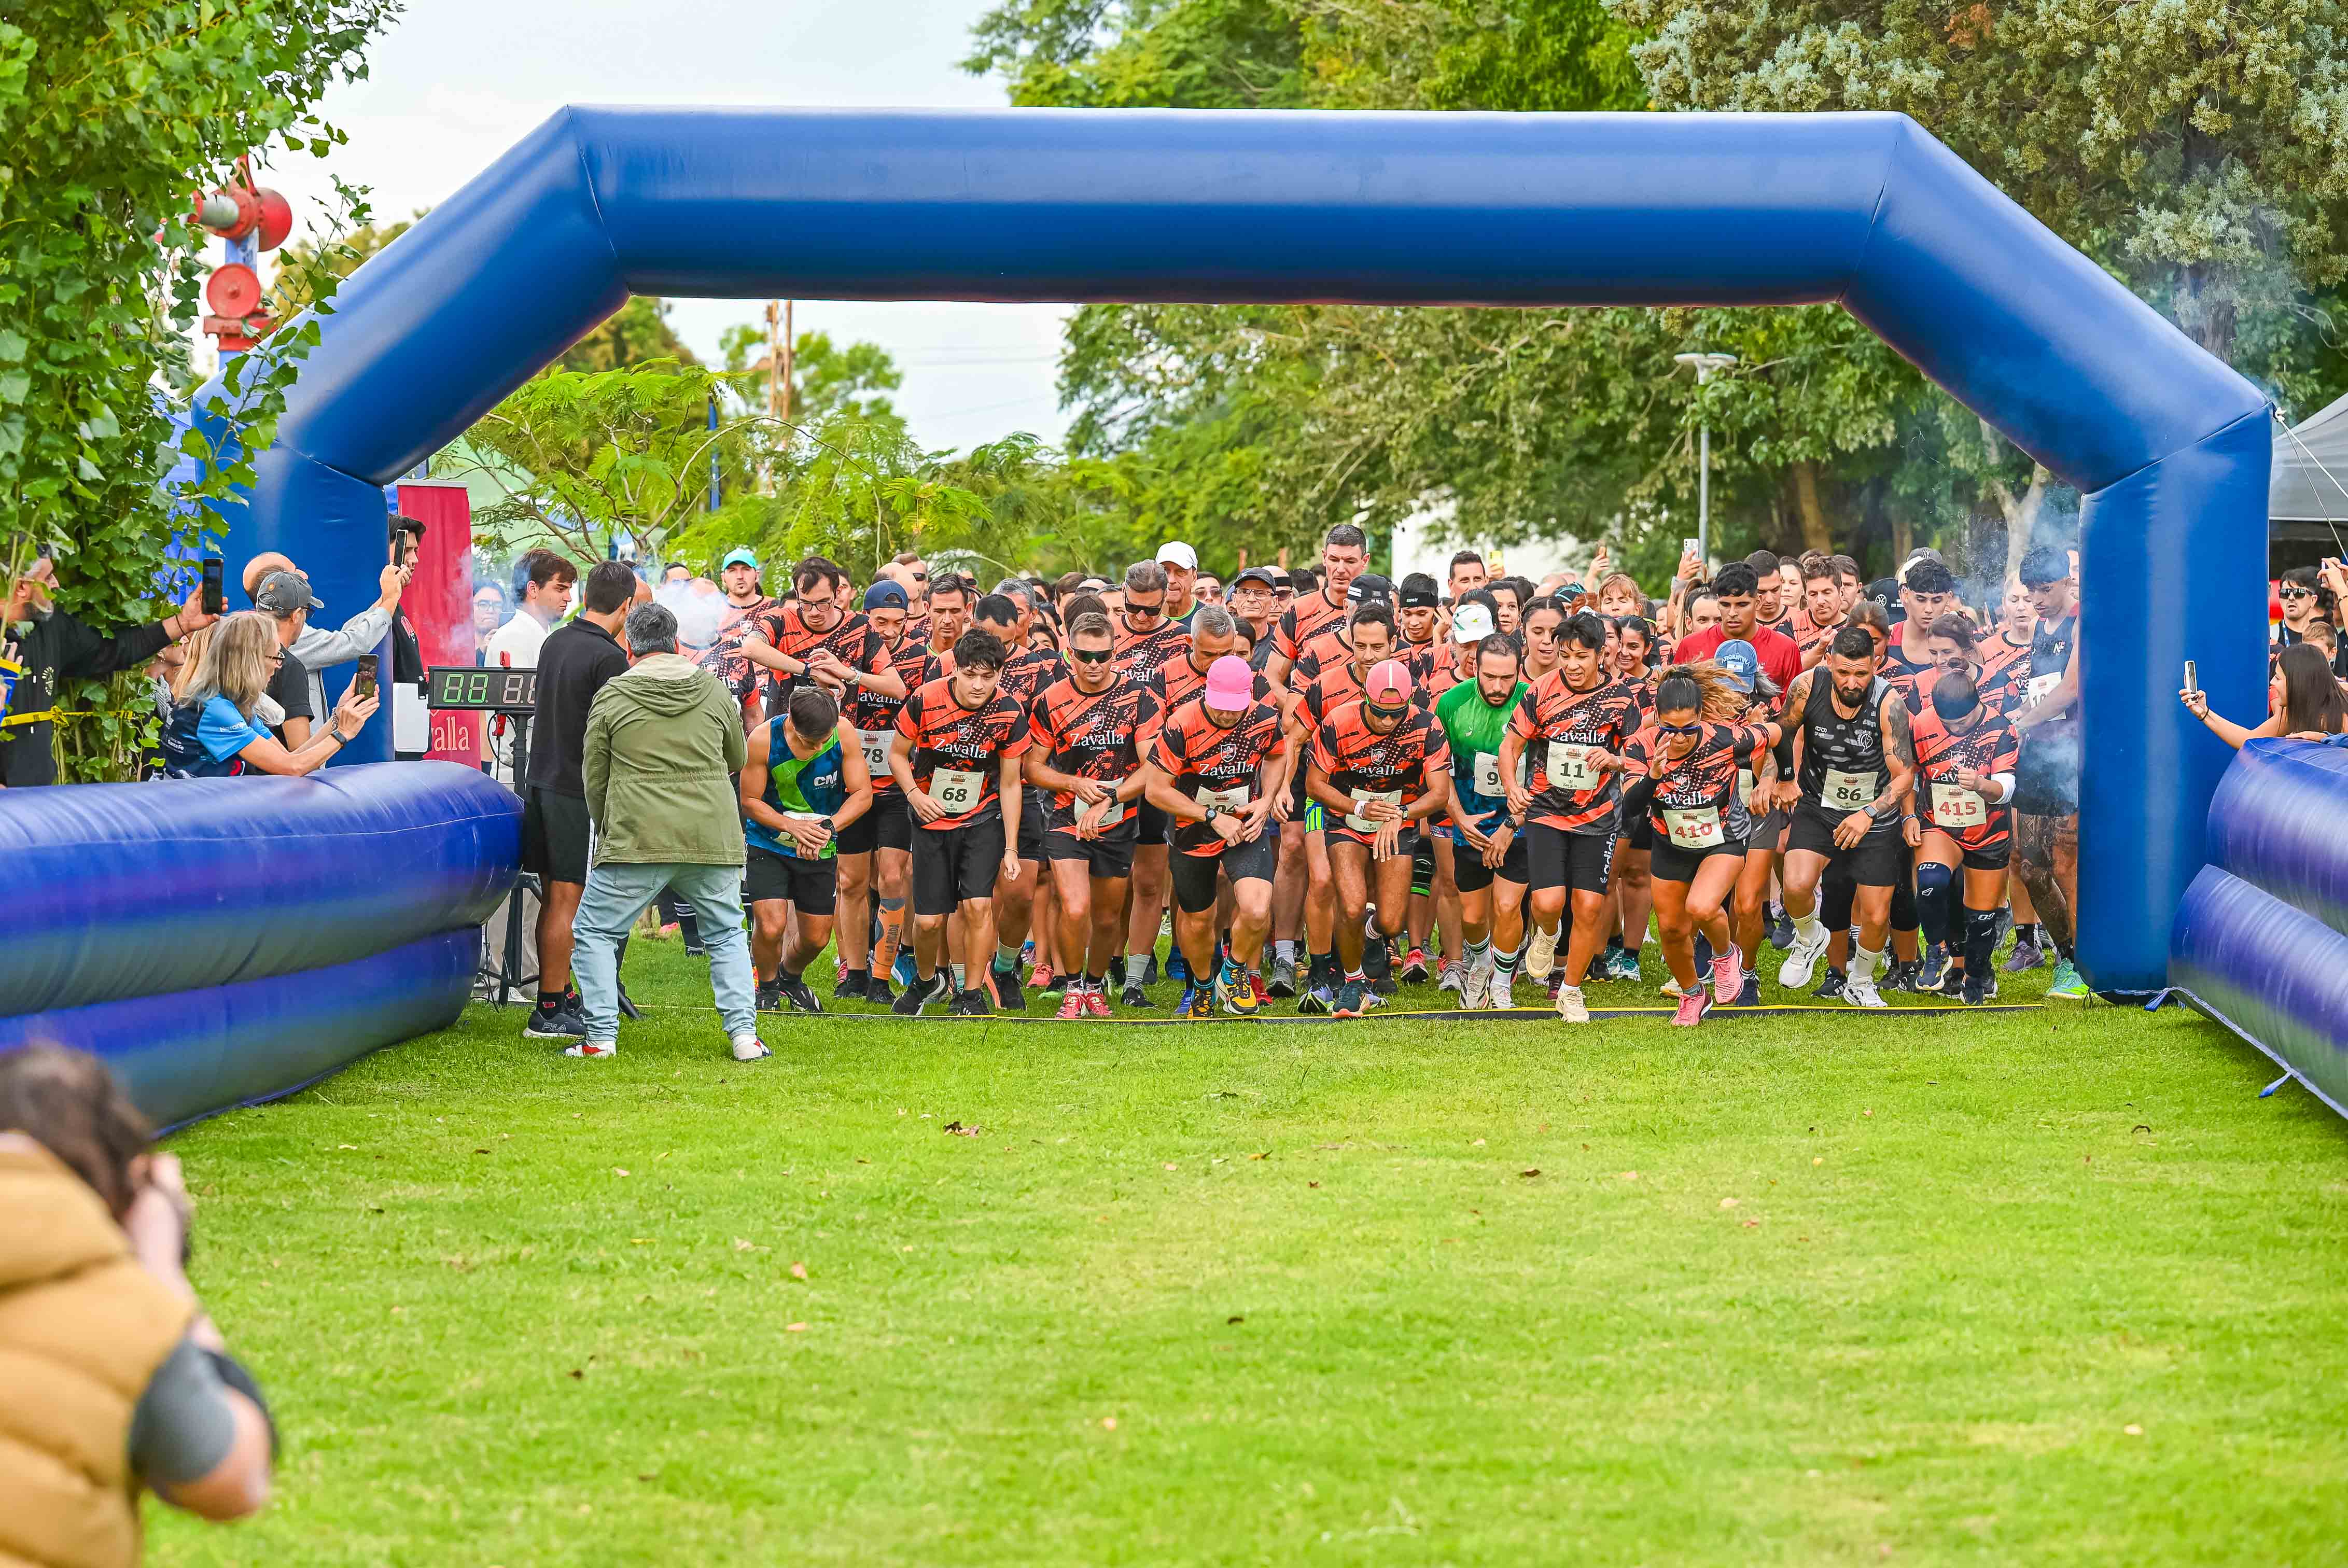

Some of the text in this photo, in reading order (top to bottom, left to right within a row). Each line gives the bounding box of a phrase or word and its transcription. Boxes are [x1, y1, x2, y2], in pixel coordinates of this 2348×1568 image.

[1721, 654, 1751, 667] ARGENTINA
[431, 716, 470, 751] alla
[1070, 730, 1124, 747] Zavalla
[1550, 726, 1605, 743] Zavalla
[861, 748, 884, 763] 78
[934, 737, 988, 759] Zavalla
[1199, 761, 1253, 776] Zavalla
[1350, 763, 1403, 775] Zavalla
[1560, 762, 1584, 778] 11
[814, 770, 838, 787] CM
[1487, 772, 1499, 786] 9
[942, 787, 968, 802] 68
[1662, 791, 1712, 805] avalla
[1836, 787, 1862, 801] 86
[1939, 801, 1977, 816] 415
[1675, 822, 1712, 838] 410
[1603, 832, 1617, 875] adida
[541, 1022, 567, 1033] FILA
